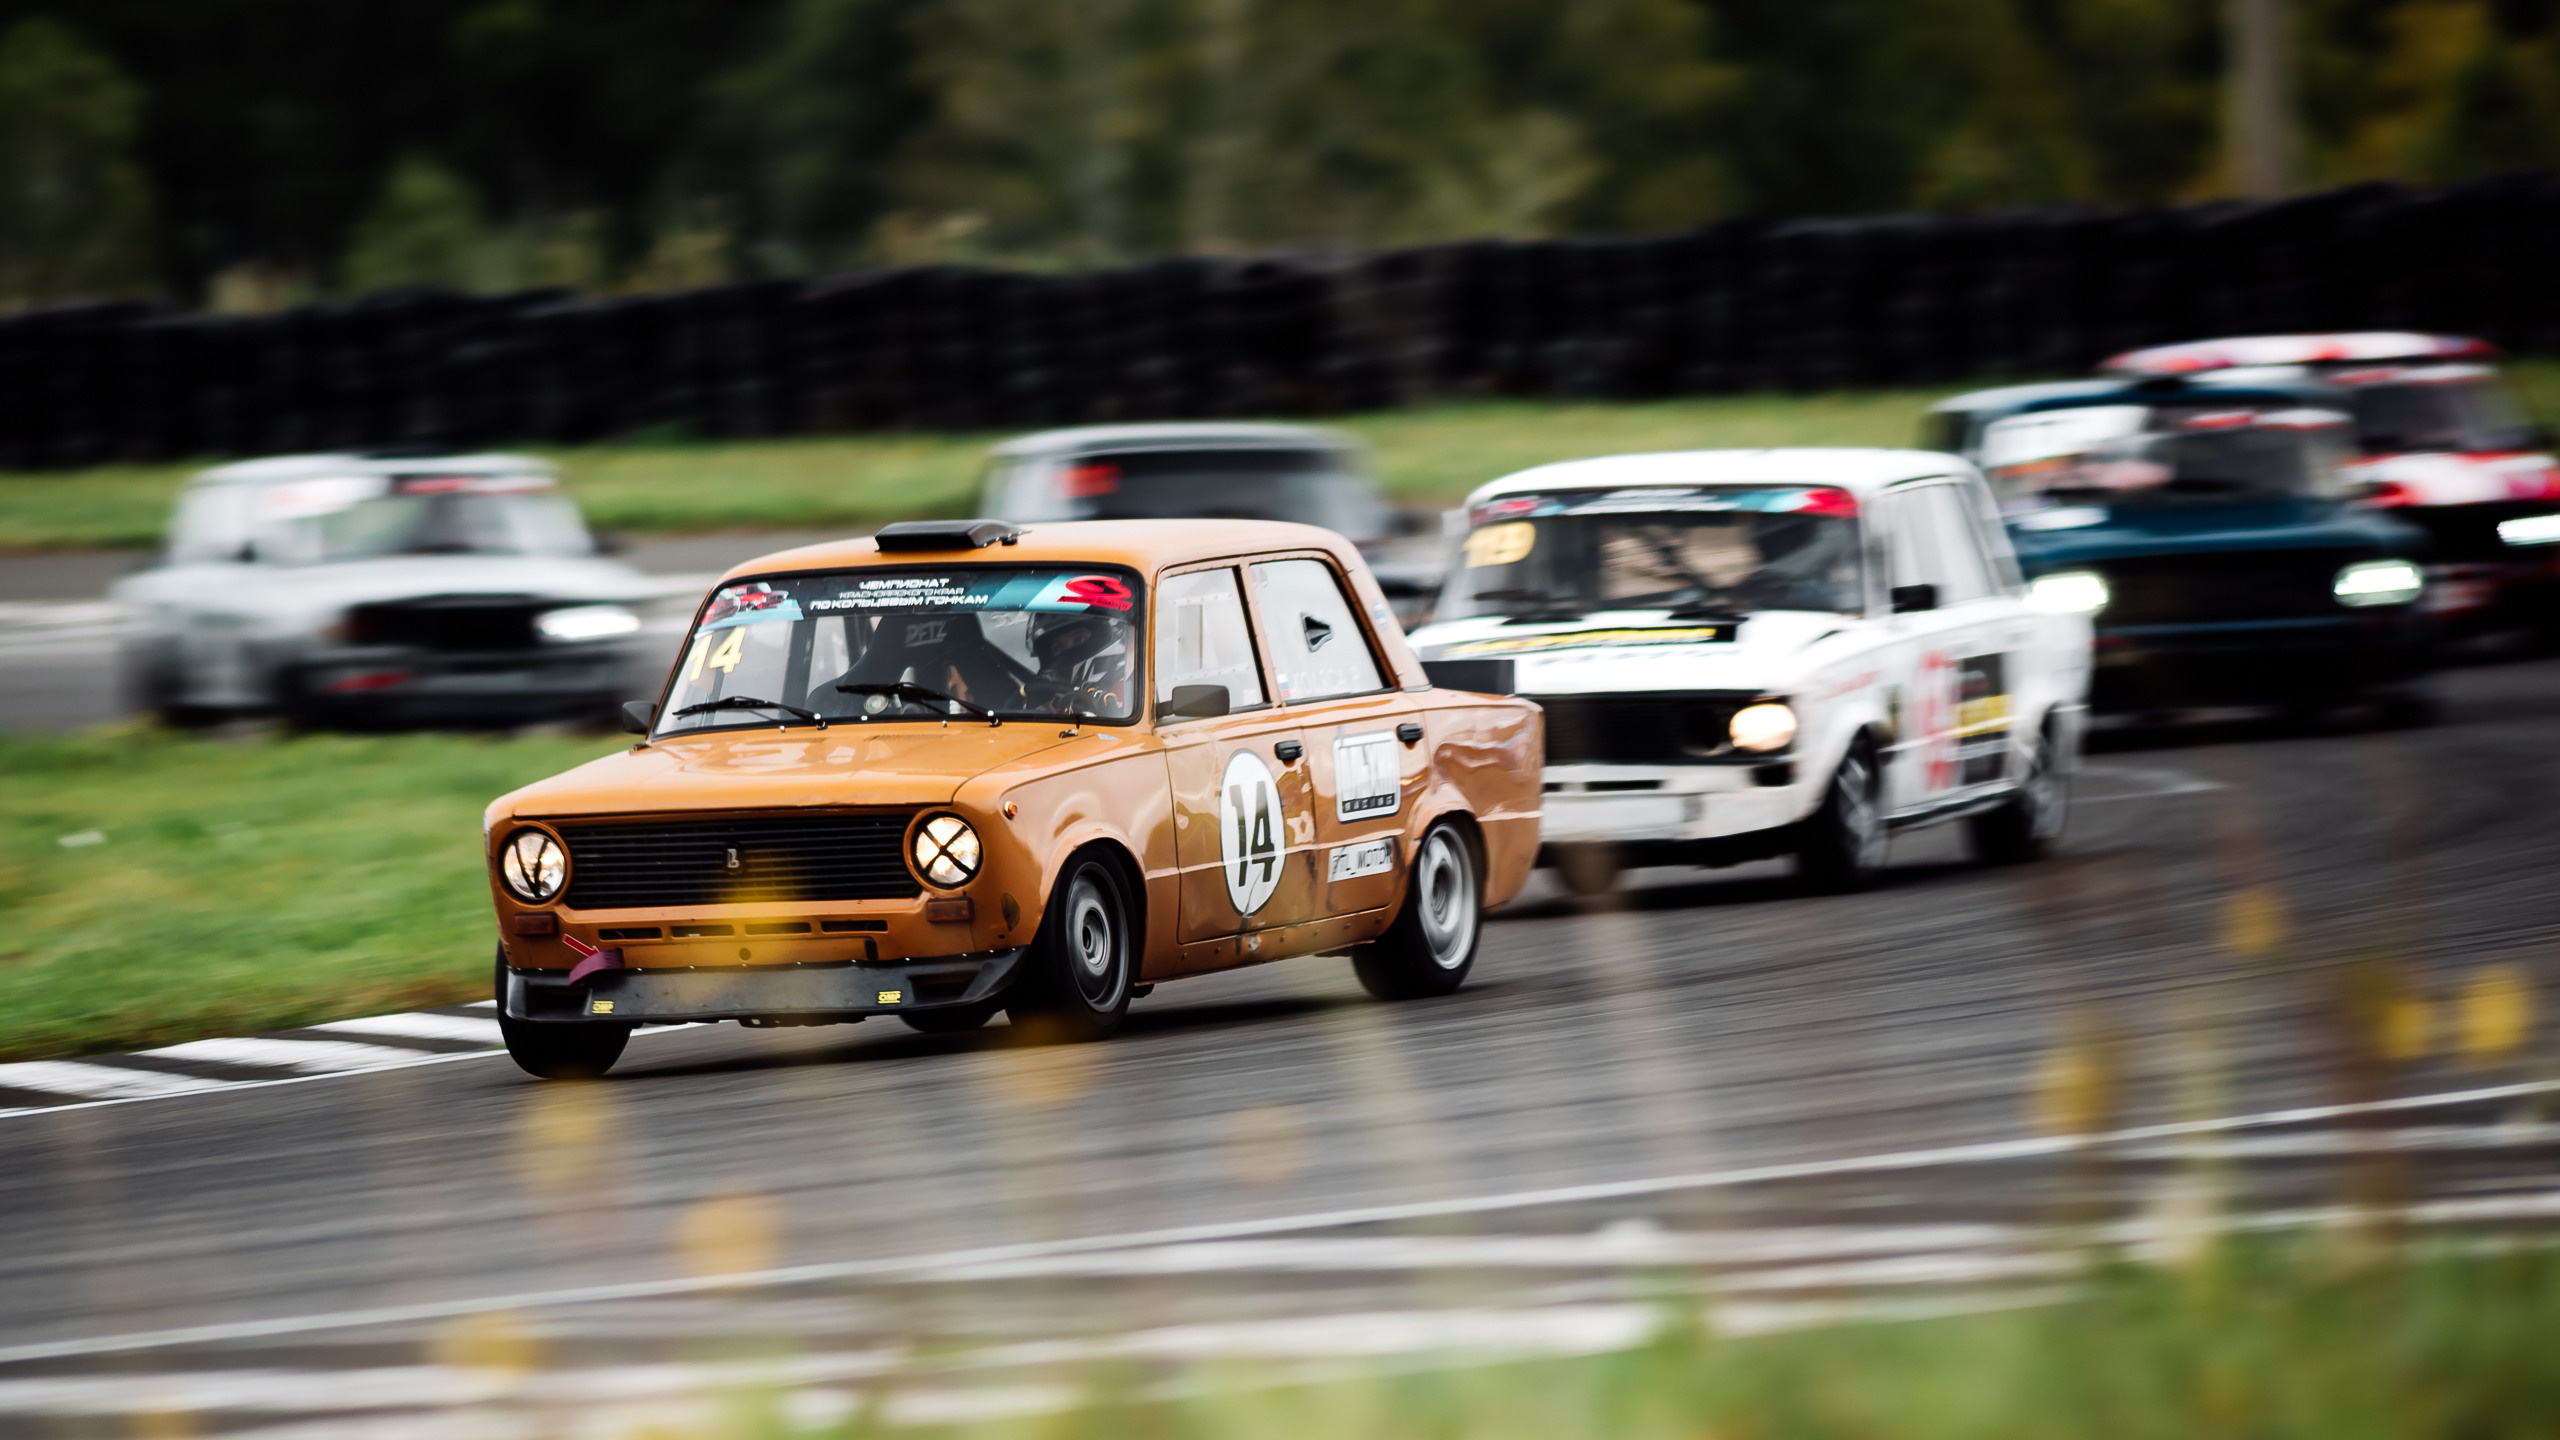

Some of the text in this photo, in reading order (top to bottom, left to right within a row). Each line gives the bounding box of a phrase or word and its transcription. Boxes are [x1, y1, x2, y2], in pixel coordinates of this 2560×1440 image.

[859, 578, 949, 590] ЧЕМПИОНАТ
[810, 595, 988, 610] ПО КОЛЬЦЕВЫМ ГОНКАМ
[688, 626, 746, 682] 14
[1229, 780, 1276, 888] 14
